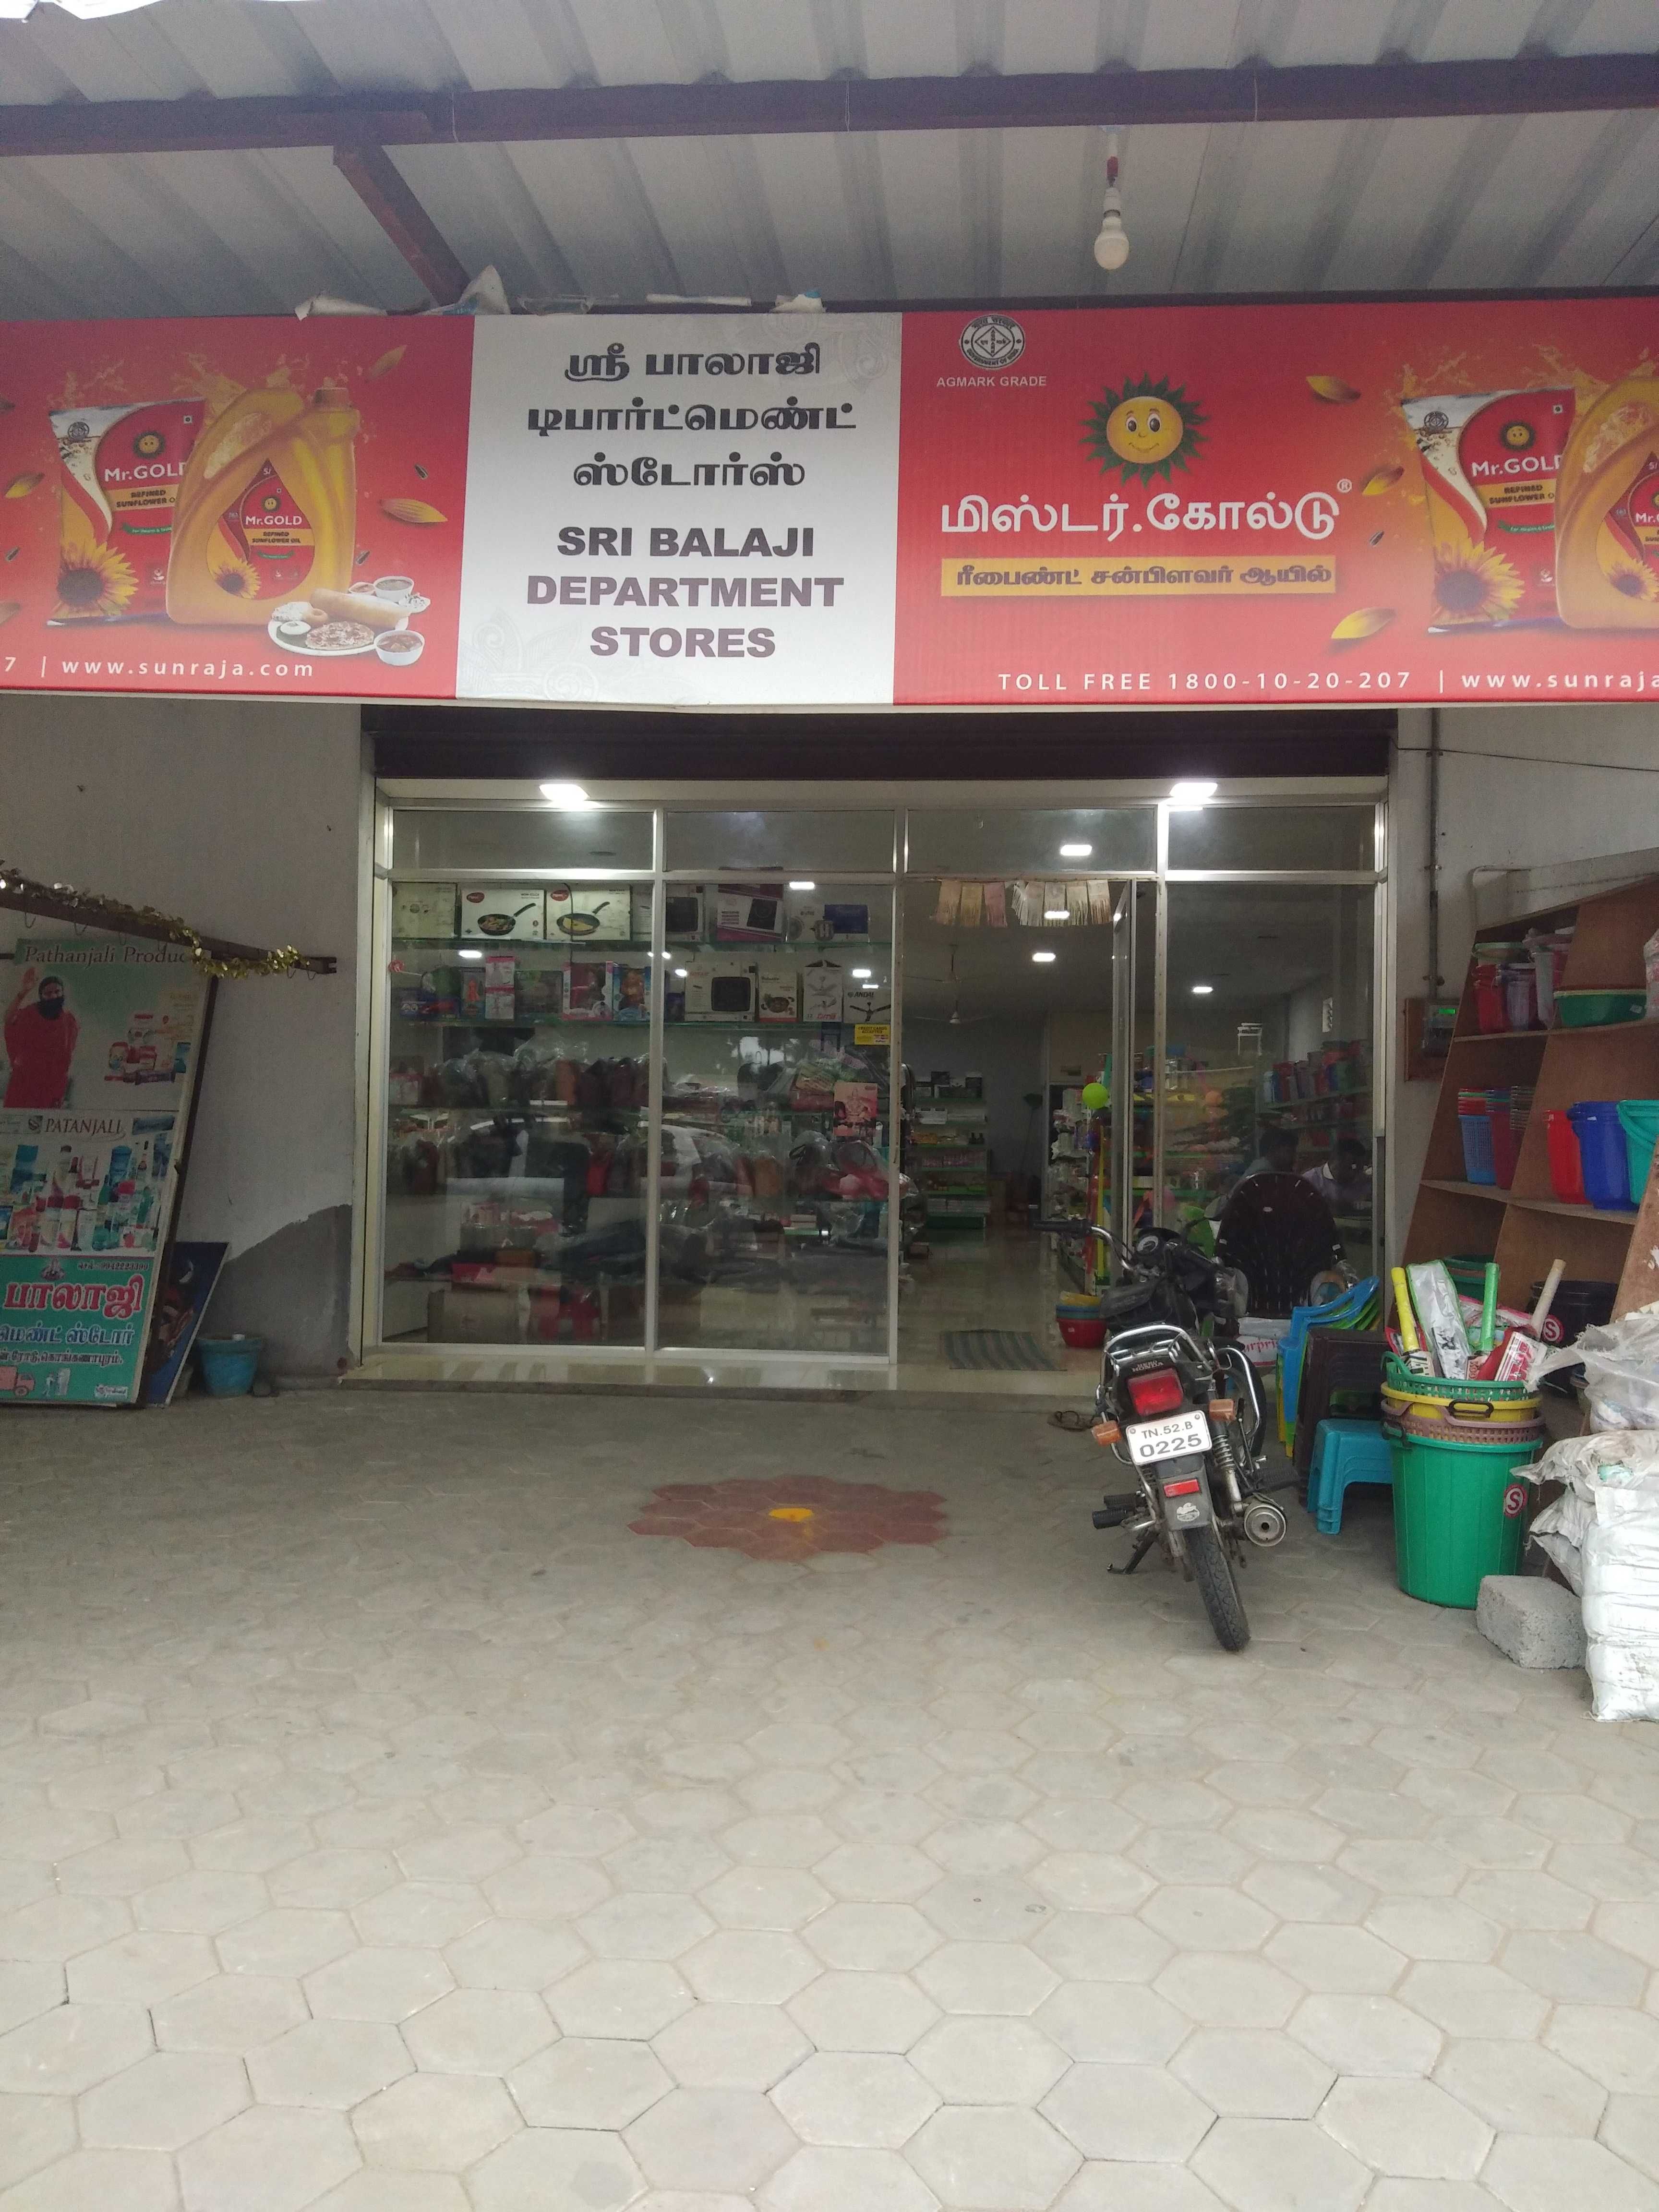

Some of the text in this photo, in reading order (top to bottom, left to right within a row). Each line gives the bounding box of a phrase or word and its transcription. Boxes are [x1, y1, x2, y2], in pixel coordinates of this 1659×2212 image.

[646, 342, 820, 375] பாலாஜி
[937, 375, 1047, 387] AGMARK GRADE
[528, 396, 857, 437] டிபார்ட்மெண்ட்
[574, 452, 805, 486] ஸ்டோர்ஸ்
[245, 515, 303, 526] Mr.GOLD
[557, 527, 814, 557] SRI BALAJI
[957, 564, 1332, 586] ரீபைண்ட் சன்பிளவர் ஆயில்
[527, 575, 845, 607] DEPARTMENT
[590, 626, 776, 658] STORES
[62, 660, 313, 679] www.sunraja.com
[998, 673, 1067, 690] TOLL
[1084, 673, 1151, 690] FREE
[1169, 672, 1410, 690] 1800-10-20-207
[25, 945, 115, 969] Pathanjali
[46, 1117, 122, 1136] PATANJALI
[2, 1273, 145, 1320] பாலாஜி
[1132, 1362, 1164, 1372] HONDA
[1141, 1421, 1193, 1439] TN.52.B
[1139, 1433, 1202, 1457] 0225
